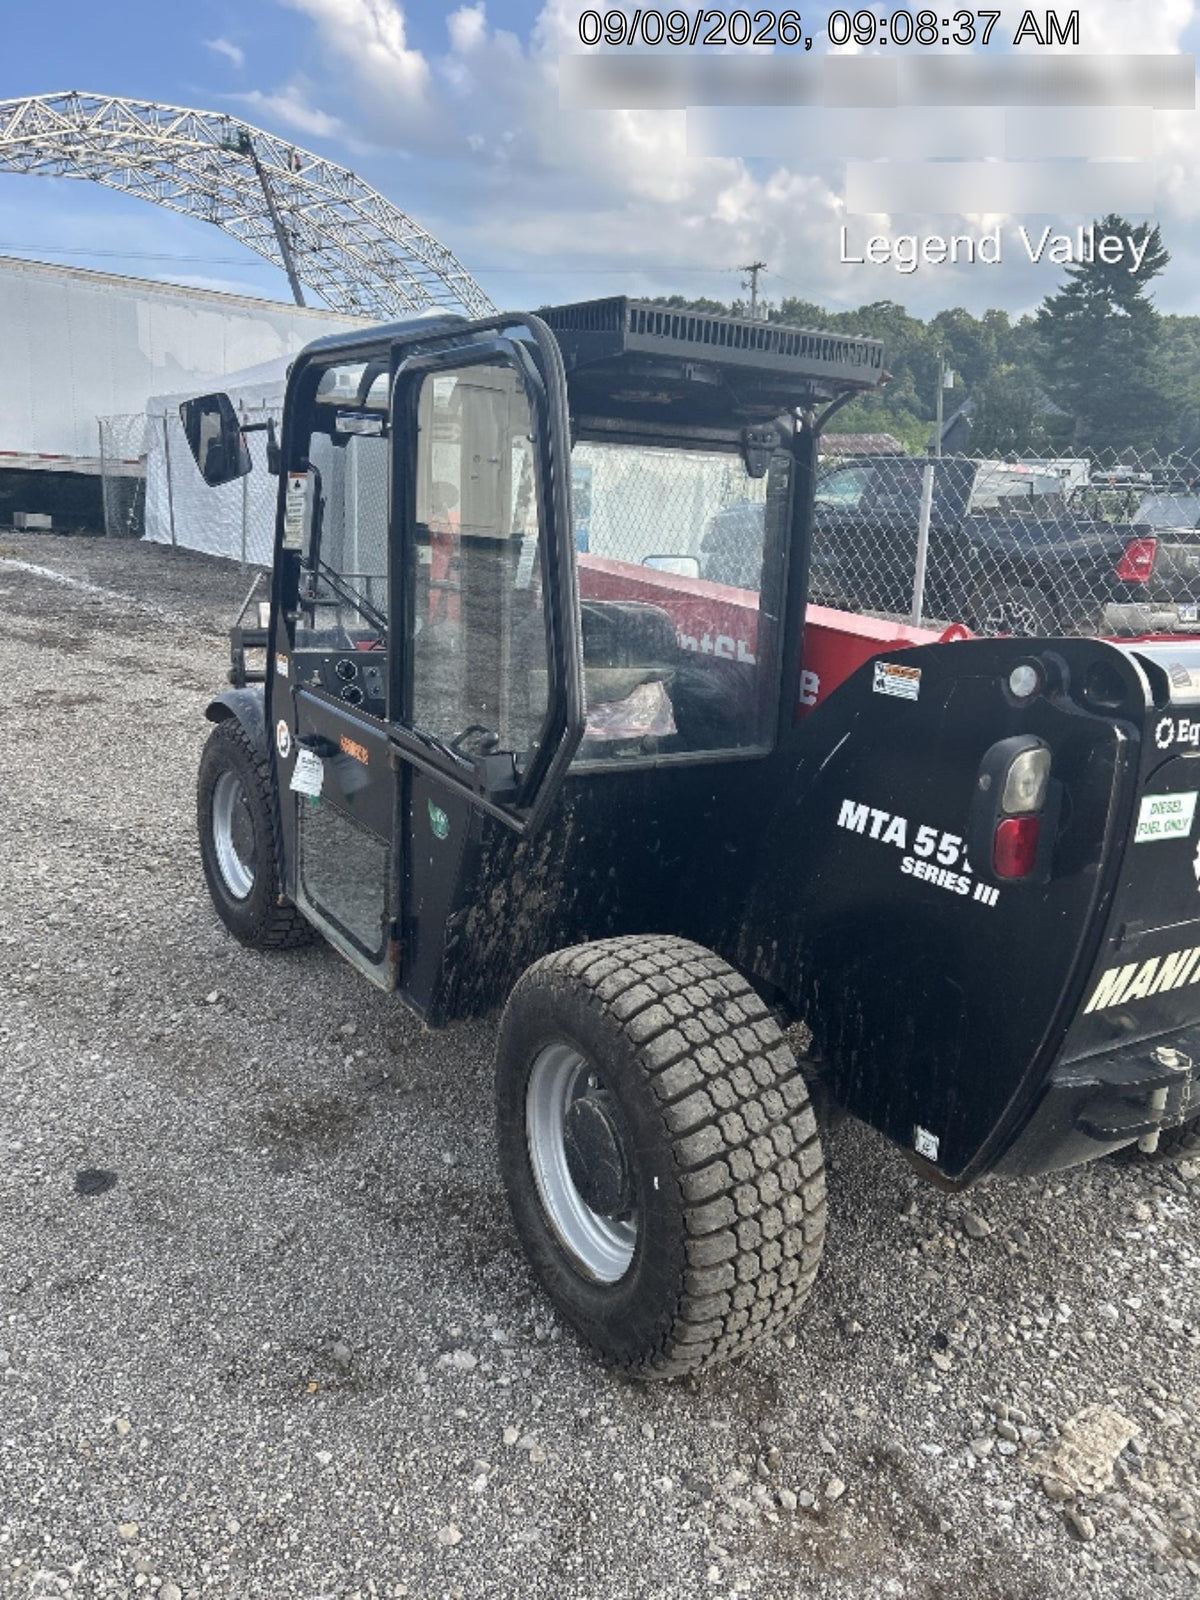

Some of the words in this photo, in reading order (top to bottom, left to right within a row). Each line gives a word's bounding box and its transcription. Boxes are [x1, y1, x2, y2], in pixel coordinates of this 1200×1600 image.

[1137, 820, 1162, 836] FUEL
[1163, 816, 1190, 834] ONLY
[1150, 799, 1183, 816] DIESEL
[836, 798, 909, 850] MTA
[913, 823, 974, 875] 55
[900, 855, 972, 897] SERIES
[973, 882, 1001, 908] III
[1083, 945, 1200, 1015] MANI
